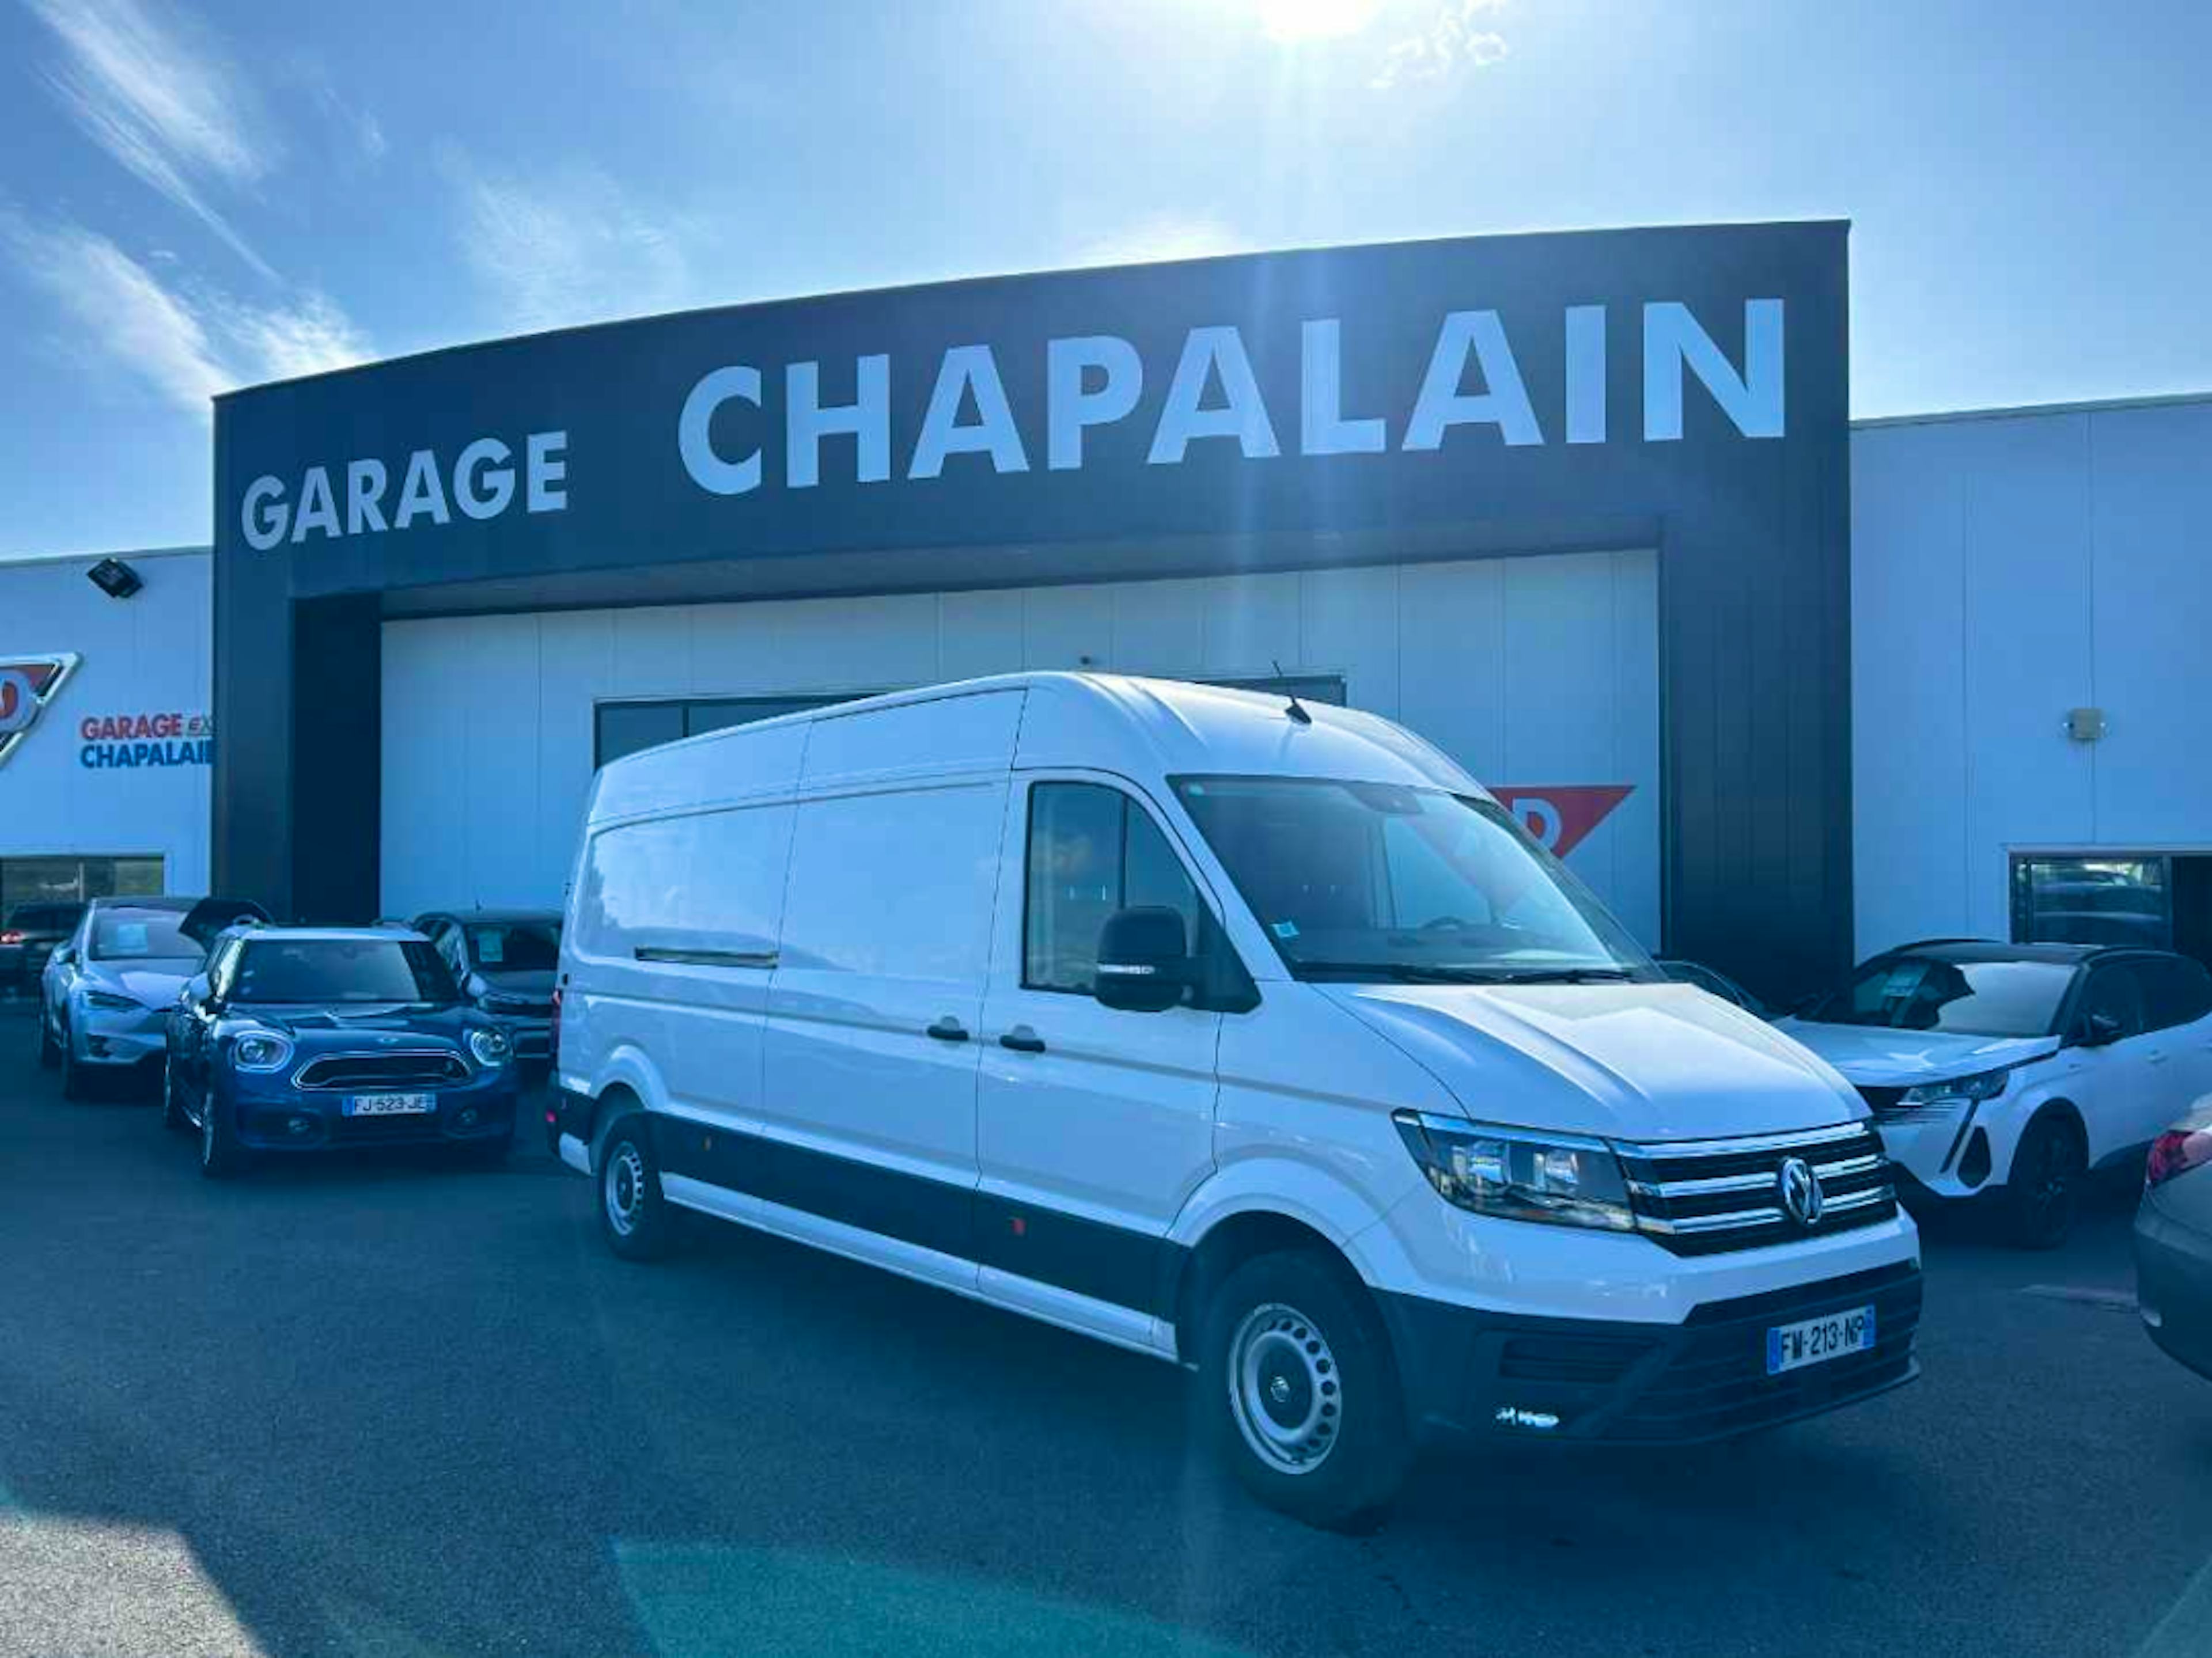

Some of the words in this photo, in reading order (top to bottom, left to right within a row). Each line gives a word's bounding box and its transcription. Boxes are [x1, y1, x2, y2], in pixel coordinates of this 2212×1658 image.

[241, 430, 567, 551] GARAGE
[678, 298, 1785, 495] CHAPALAIN
[81, 712, 183, 741] GARAGE
